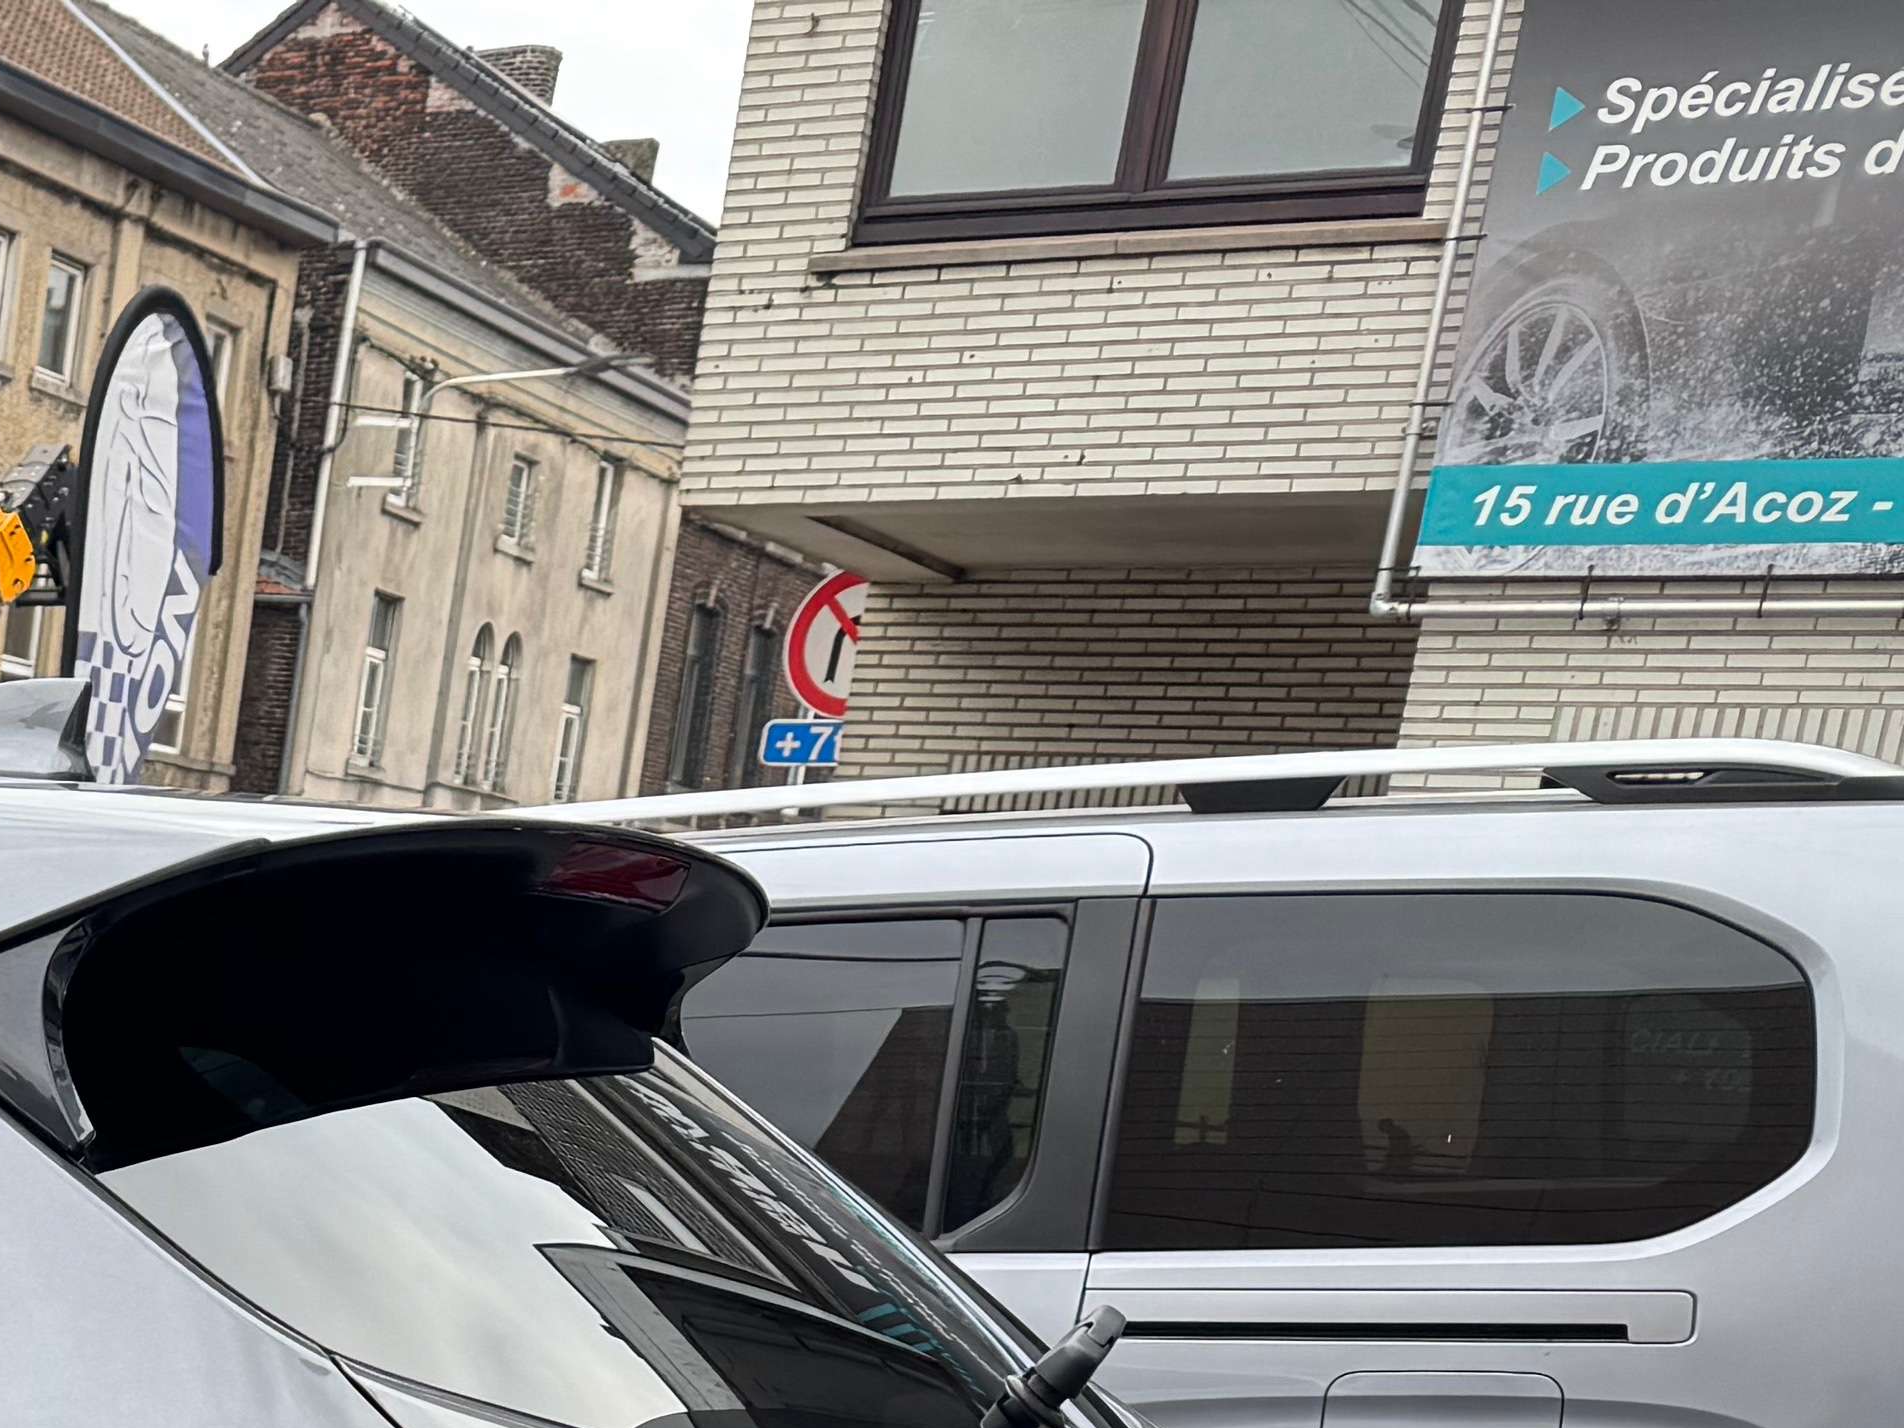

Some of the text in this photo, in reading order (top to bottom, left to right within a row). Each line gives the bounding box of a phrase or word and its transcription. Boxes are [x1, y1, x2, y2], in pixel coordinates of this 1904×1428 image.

[1579, 134, 1847, 191] Produits
[1472, 484, 1538, 527] 15
[1544, 496, 1641, 527] rue
[1654, 481, 1860, 525] d'Acoz
